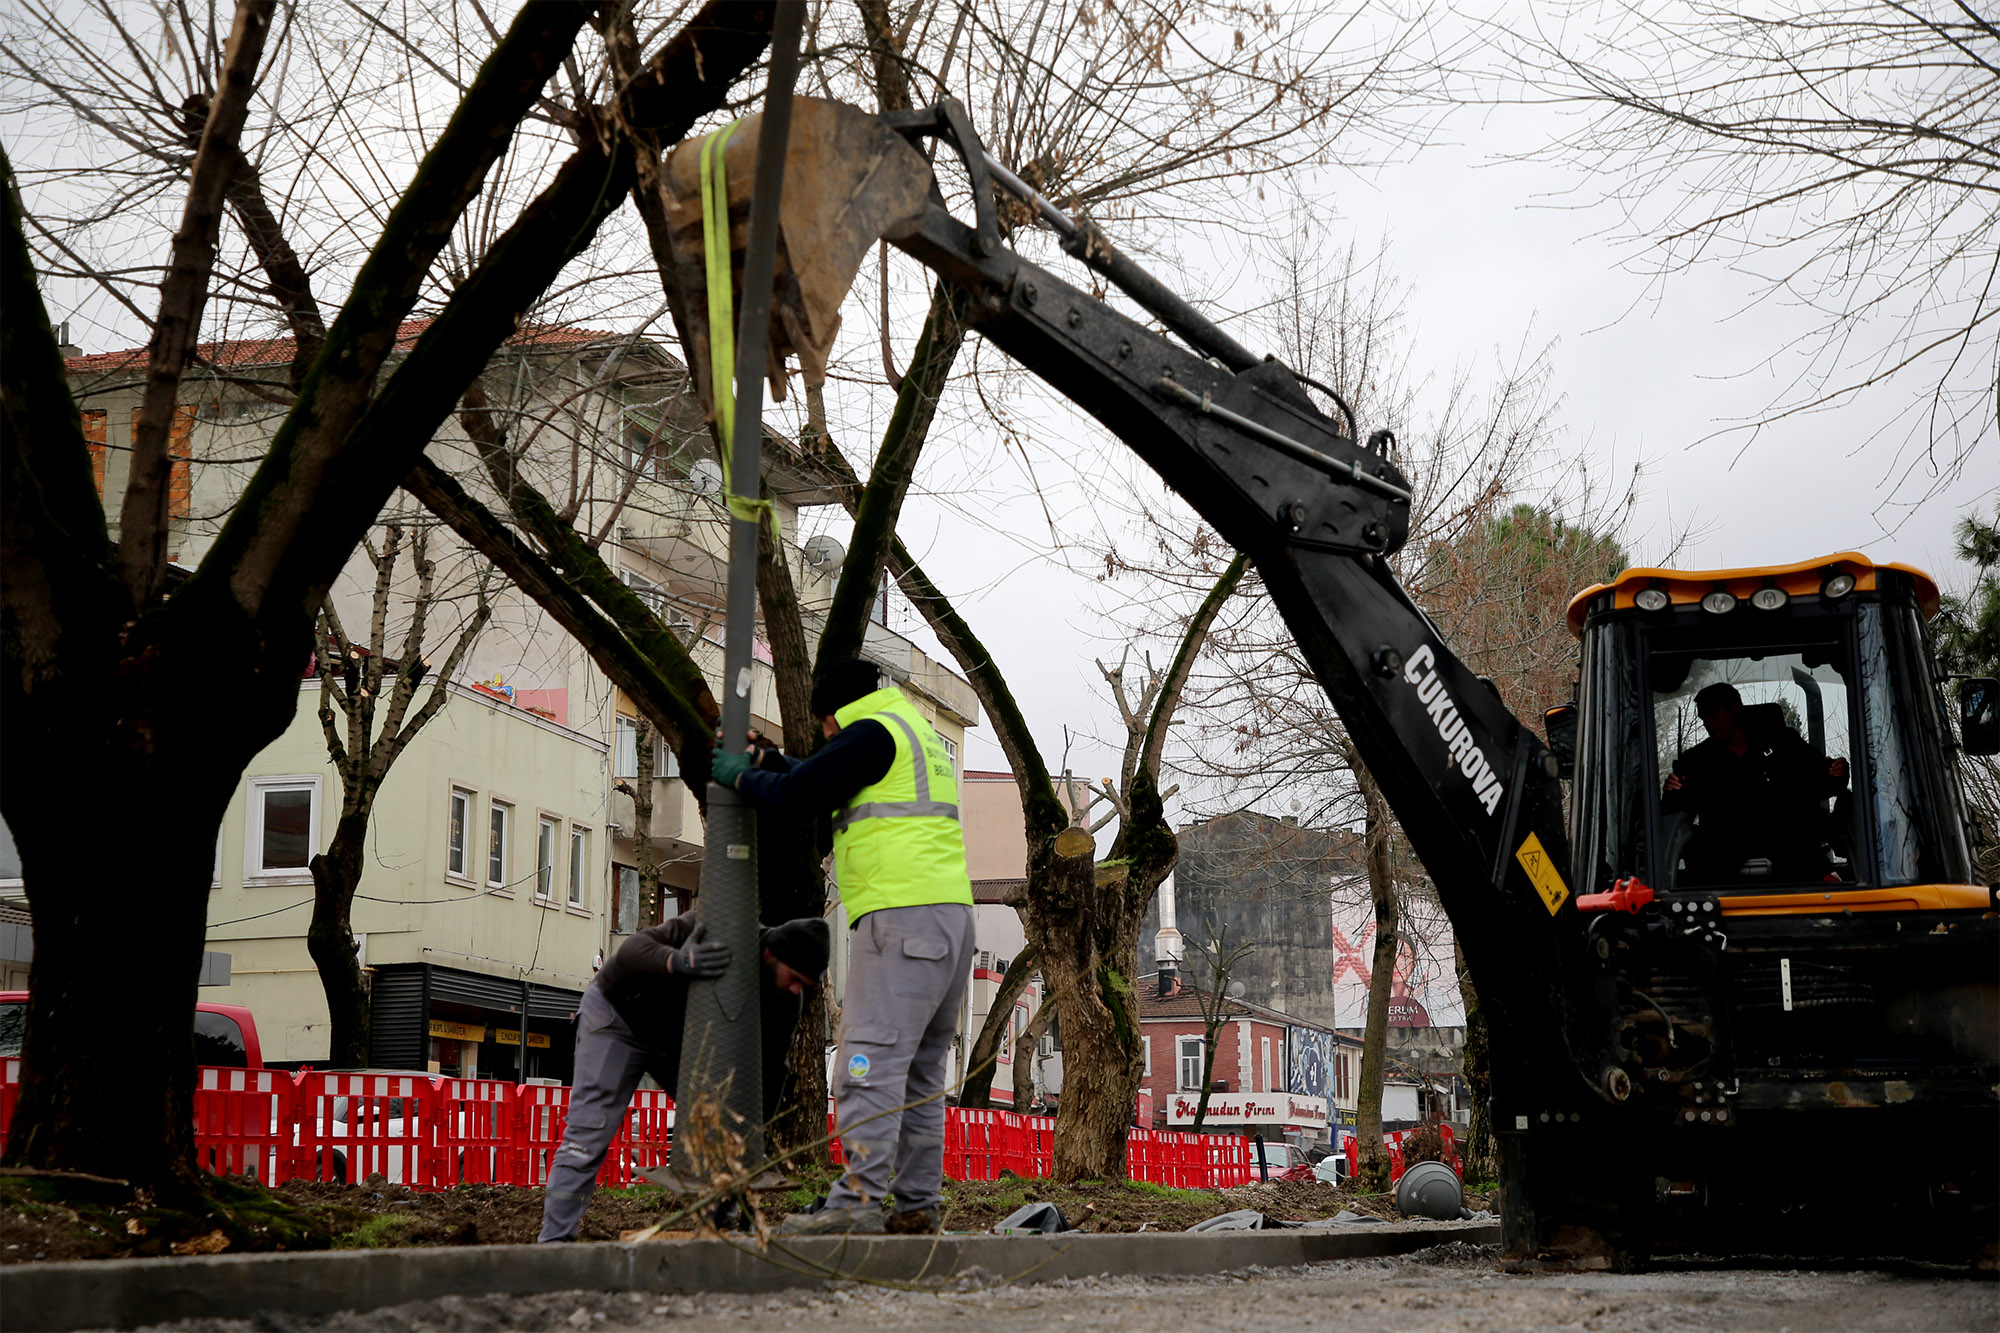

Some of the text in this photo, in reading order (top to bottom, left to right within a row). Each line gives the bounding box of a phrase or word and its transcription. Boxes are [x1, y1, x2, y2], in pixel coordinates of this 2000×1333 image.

[1403, 643, 1504, 817] ÇUKUROVA
[1388, 1005, 1418, 1015] ERUM
[1176, 1101, 1240, 1119] Mamudun
